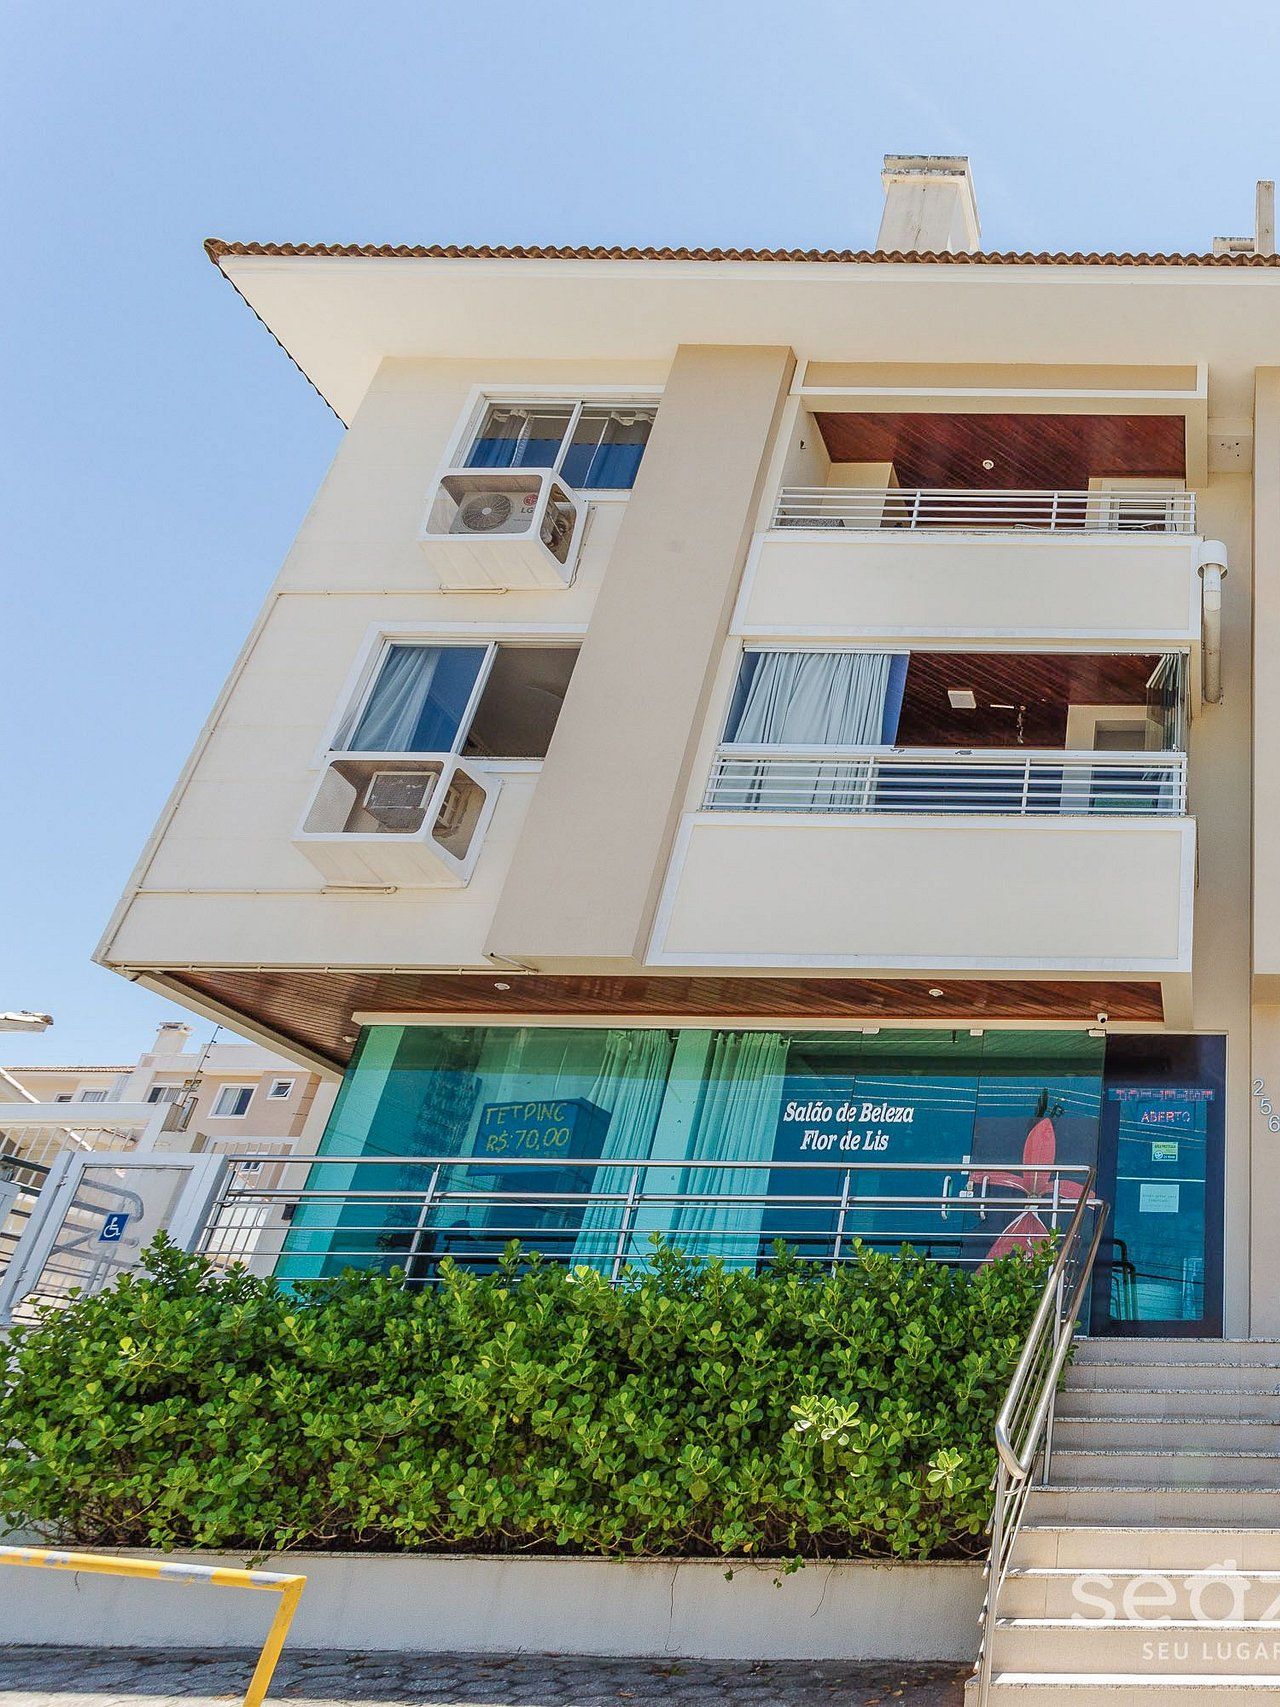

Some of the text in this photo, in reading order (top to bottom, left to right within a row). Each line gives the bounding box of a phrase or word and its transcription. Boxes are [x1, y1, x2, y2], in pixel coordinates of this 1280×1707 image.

[783, 1101, 915, 1123] Salão de Beleza
[1141, 1111, 1191, 1122] ABERTO
[1252, 1079, 1280, 1132] 256
[800, 1129, 889, 1151] Flor de Lis
